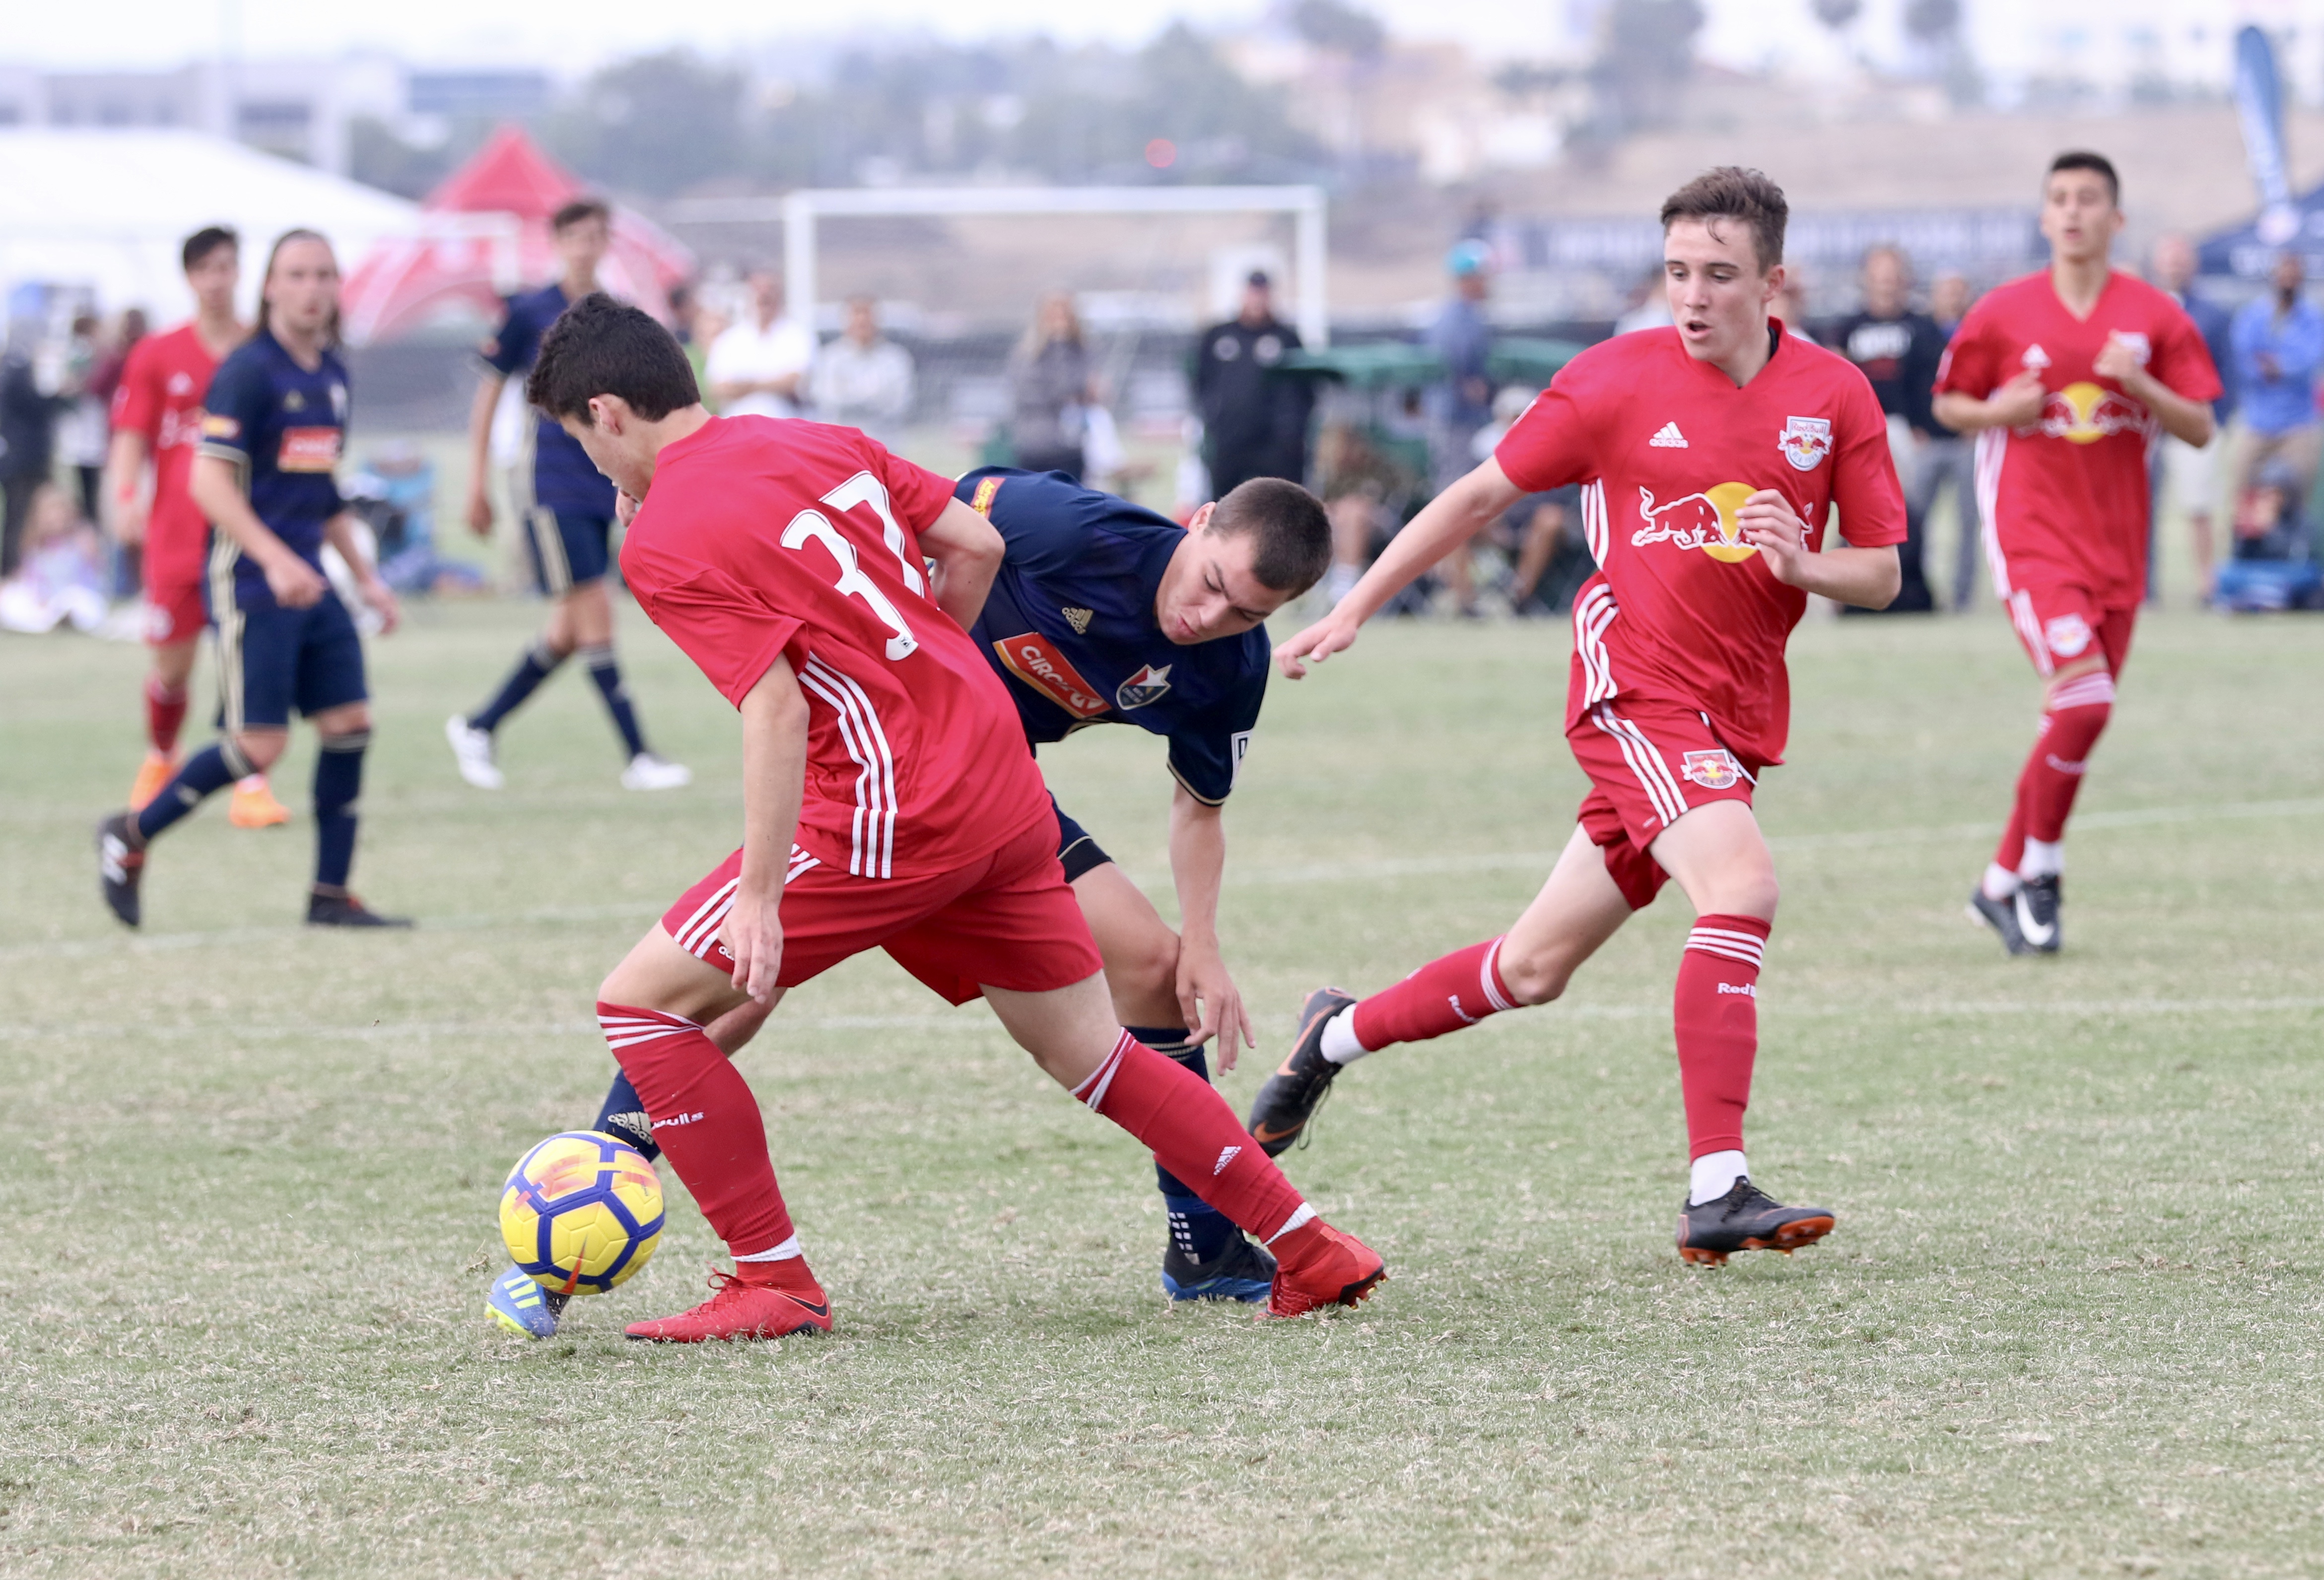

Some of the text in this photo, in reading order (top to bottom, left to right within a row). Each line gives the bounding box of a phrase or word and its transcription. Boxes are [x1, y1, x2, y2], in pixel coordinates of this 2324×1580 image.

[1649, 438, 1689, 449] adidas
[779, 469, 919, 661] 37
[1021, 646, 1076, 692] CIRC
[608, 1115, 655, 1145] adidas
